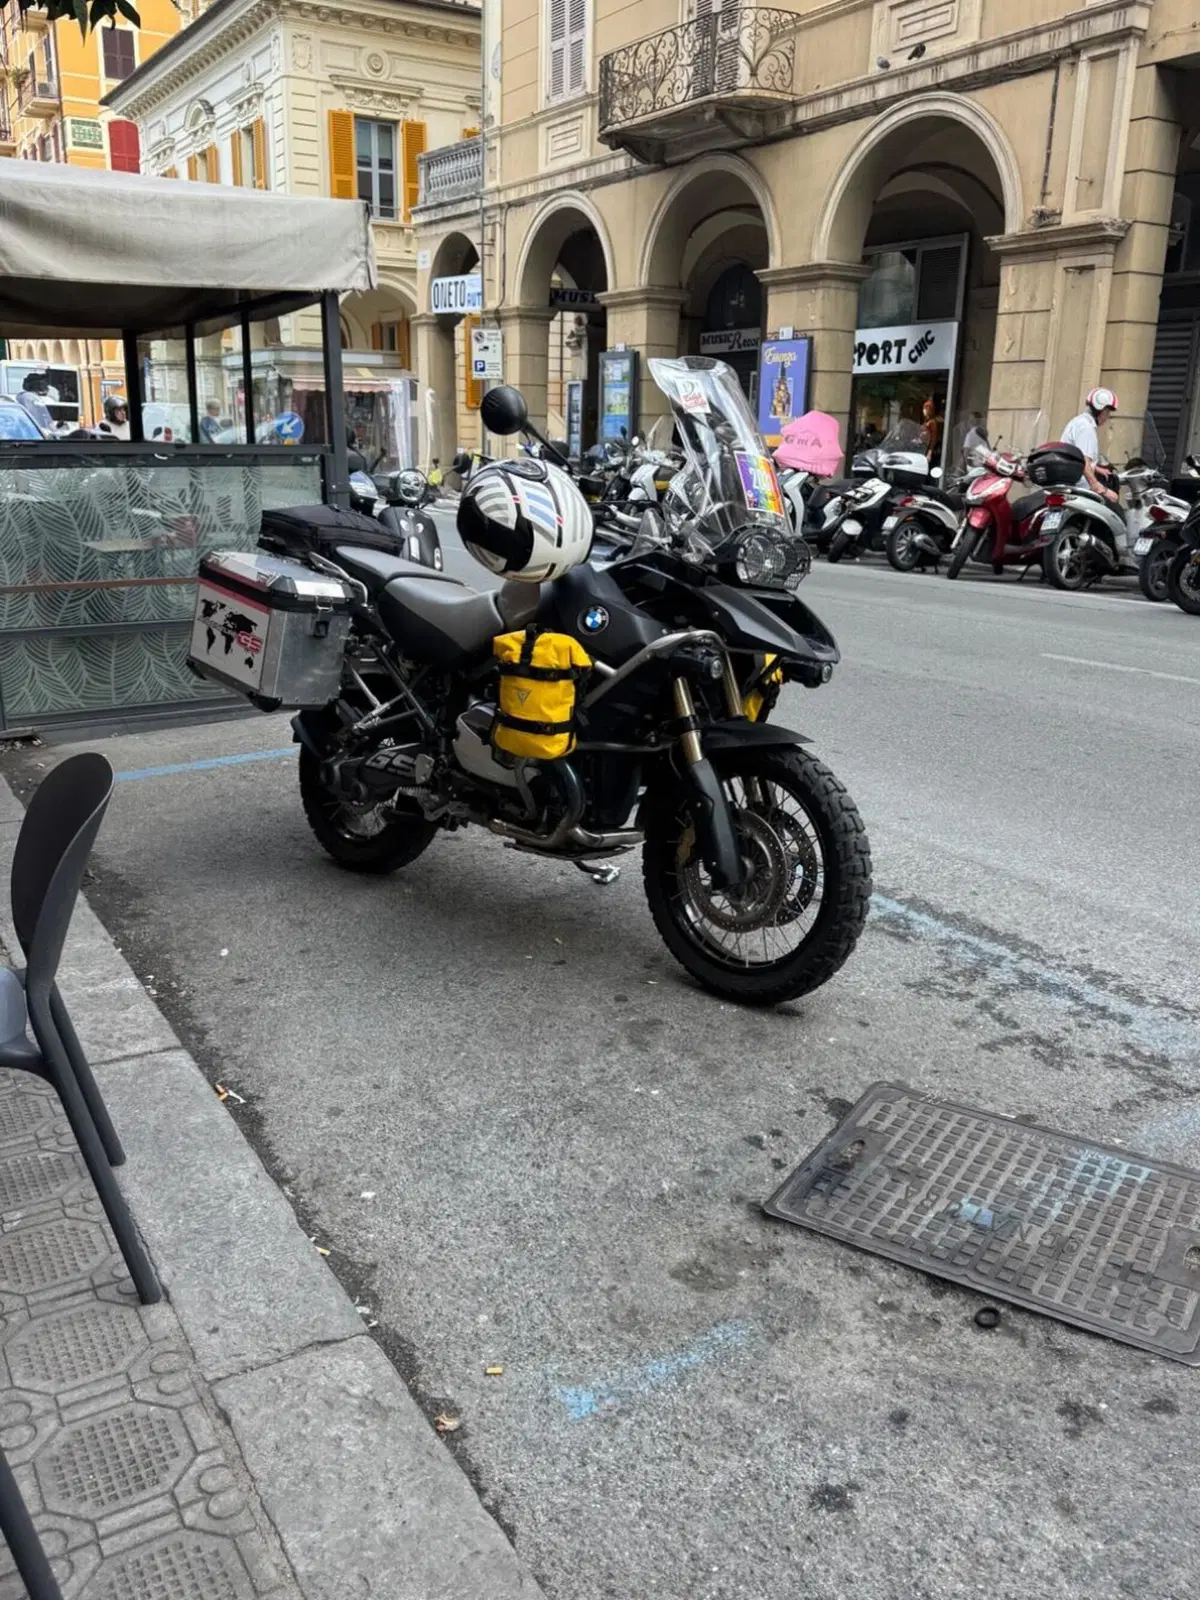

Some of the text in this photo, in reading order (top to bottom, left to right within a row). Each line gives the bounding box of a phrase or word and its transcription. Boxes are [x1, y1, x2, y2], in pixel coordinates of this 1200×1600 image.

[433, 280, 466, 308] ONETO
[853, 330, 935, 366] PORT CHIC
[365, 750, 417, 777] GS
